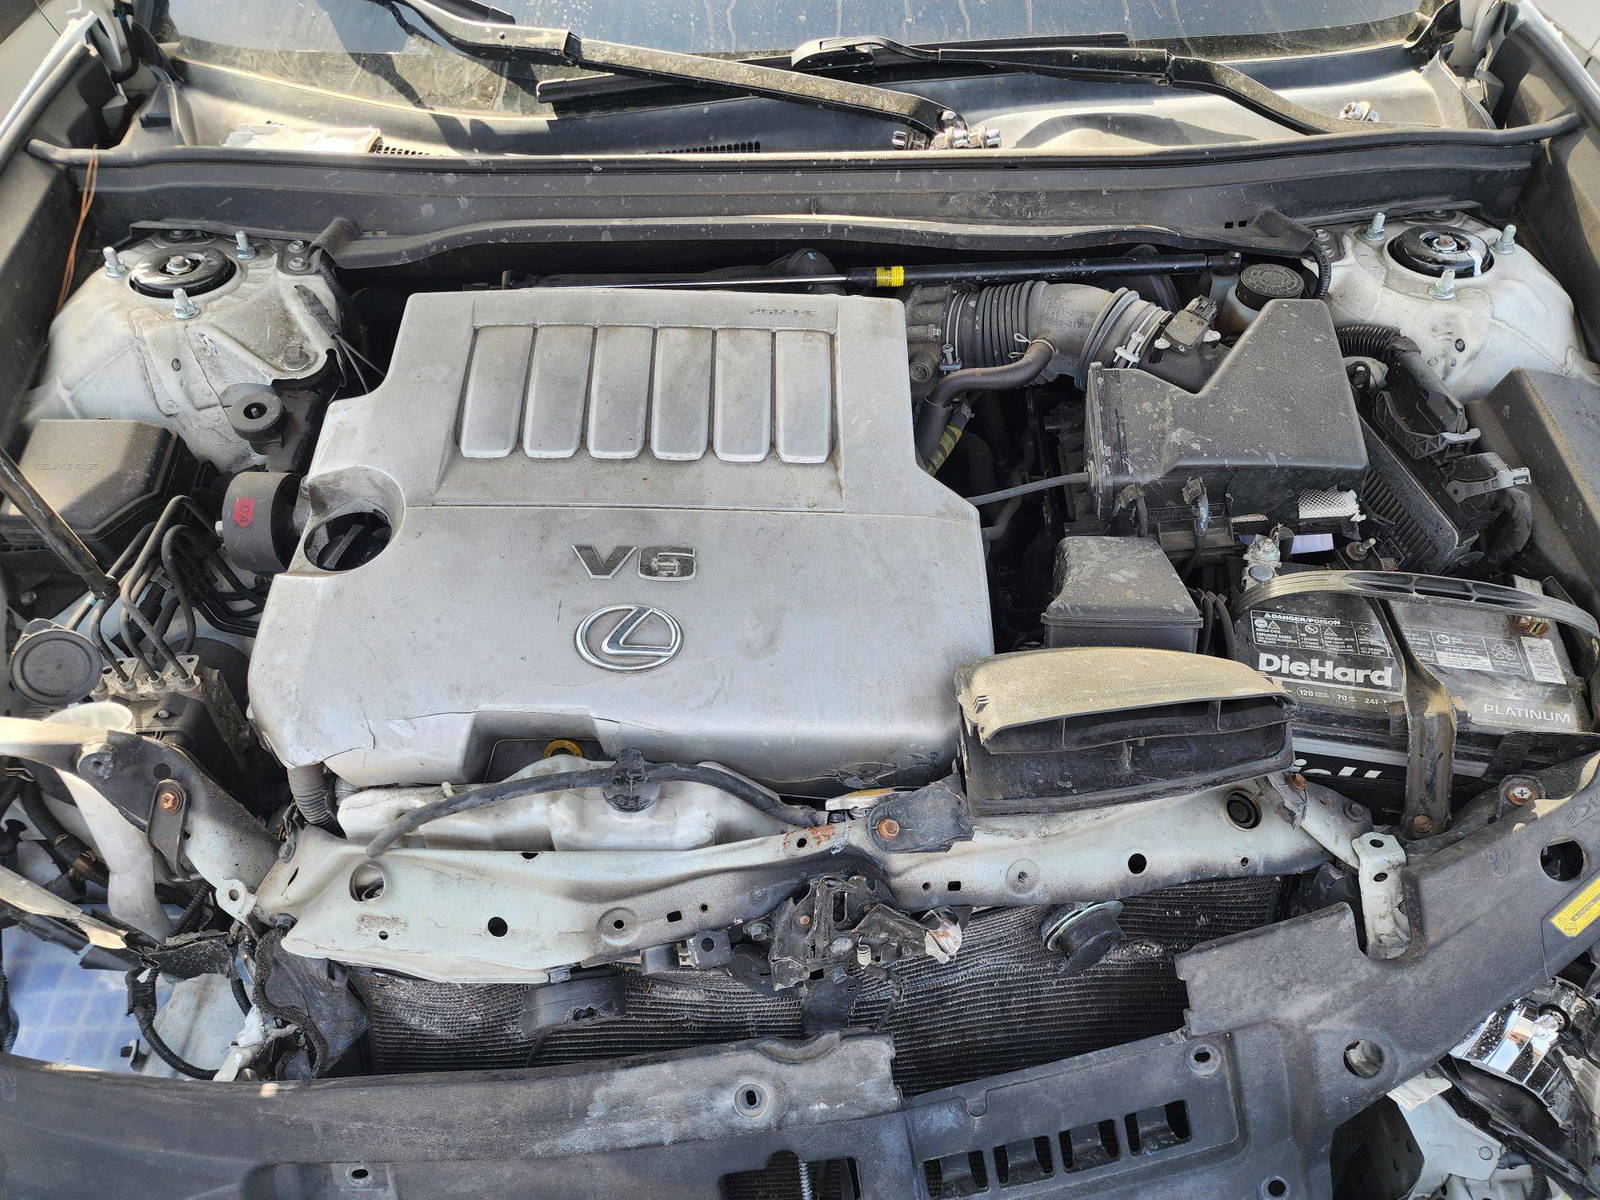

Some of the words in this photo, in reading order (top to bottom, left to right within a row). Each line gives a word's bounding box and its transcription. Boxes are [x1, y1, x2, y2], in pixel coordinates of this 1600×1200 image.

[571, 543, 697, 582] V6
[1258, 652, 1393, 688] DieHard
[1299, 689, 1314, 697] 120
[1483, 704, 1572, 724] PLATINUM
